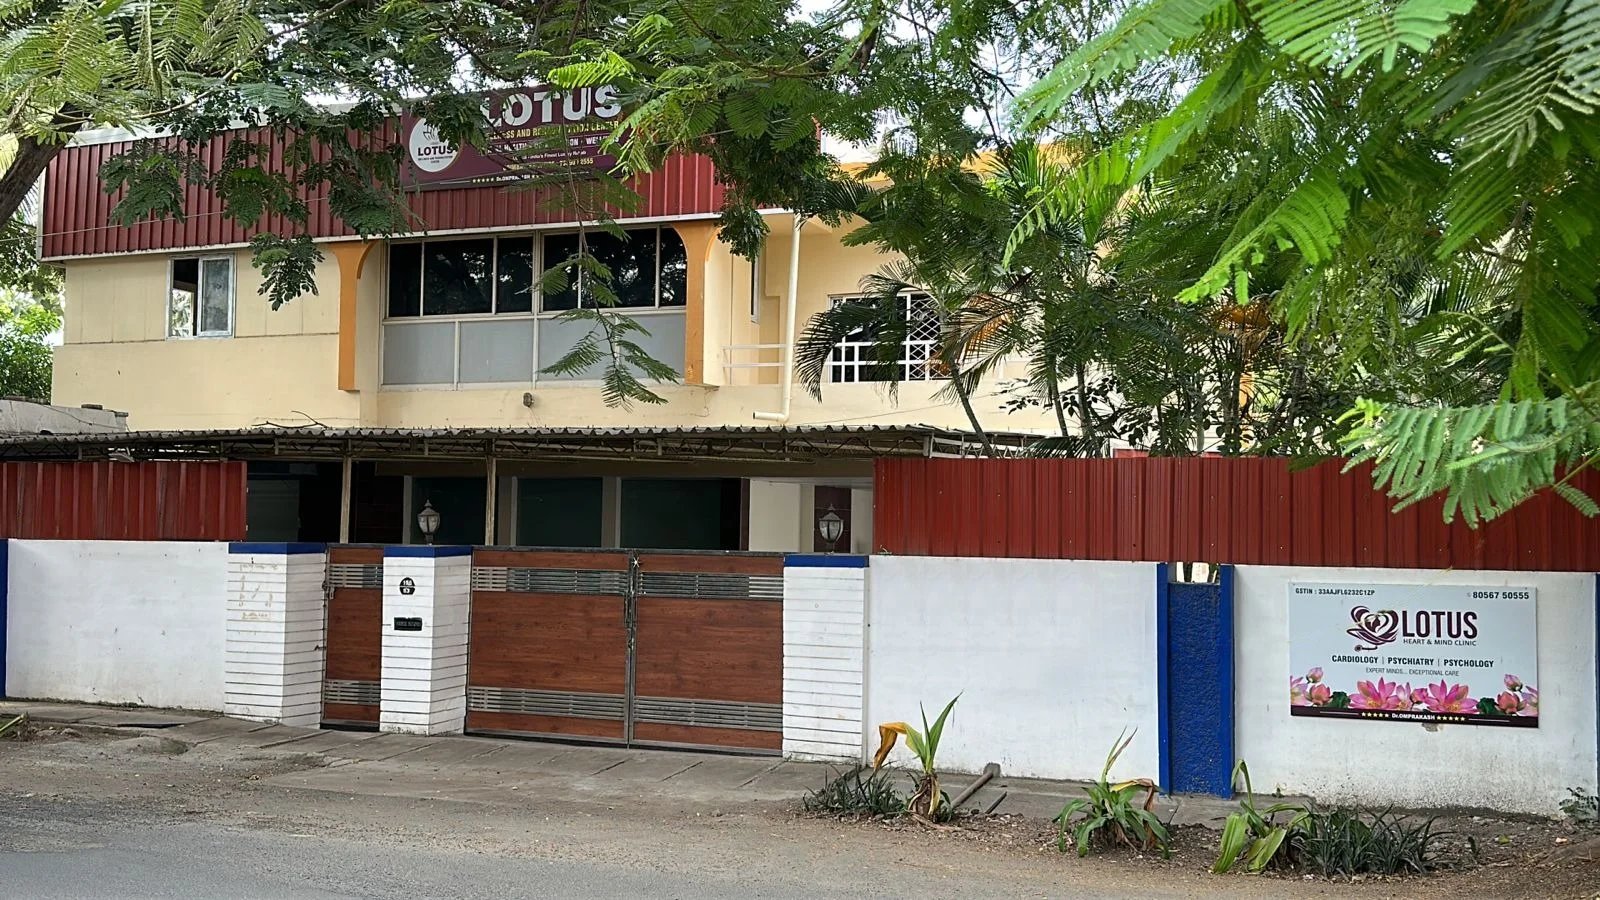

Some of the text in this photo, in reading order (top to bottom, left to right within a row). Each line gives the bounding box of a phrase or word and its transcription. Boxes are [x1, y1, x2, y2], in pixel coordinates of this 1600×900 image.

[480, 84, 622, 127] LOTUS
[516, 129, 531, 138] AND
[418, 145, 453, 156] LOTUS
[1472, 591, 1530, 600] 80567 50555
[1401, 610, 1478, 640] LOTUS
[1331, 654, 1495, 668] CARDIOLOGY PSYCHIATRY PSYCHOLOGY
